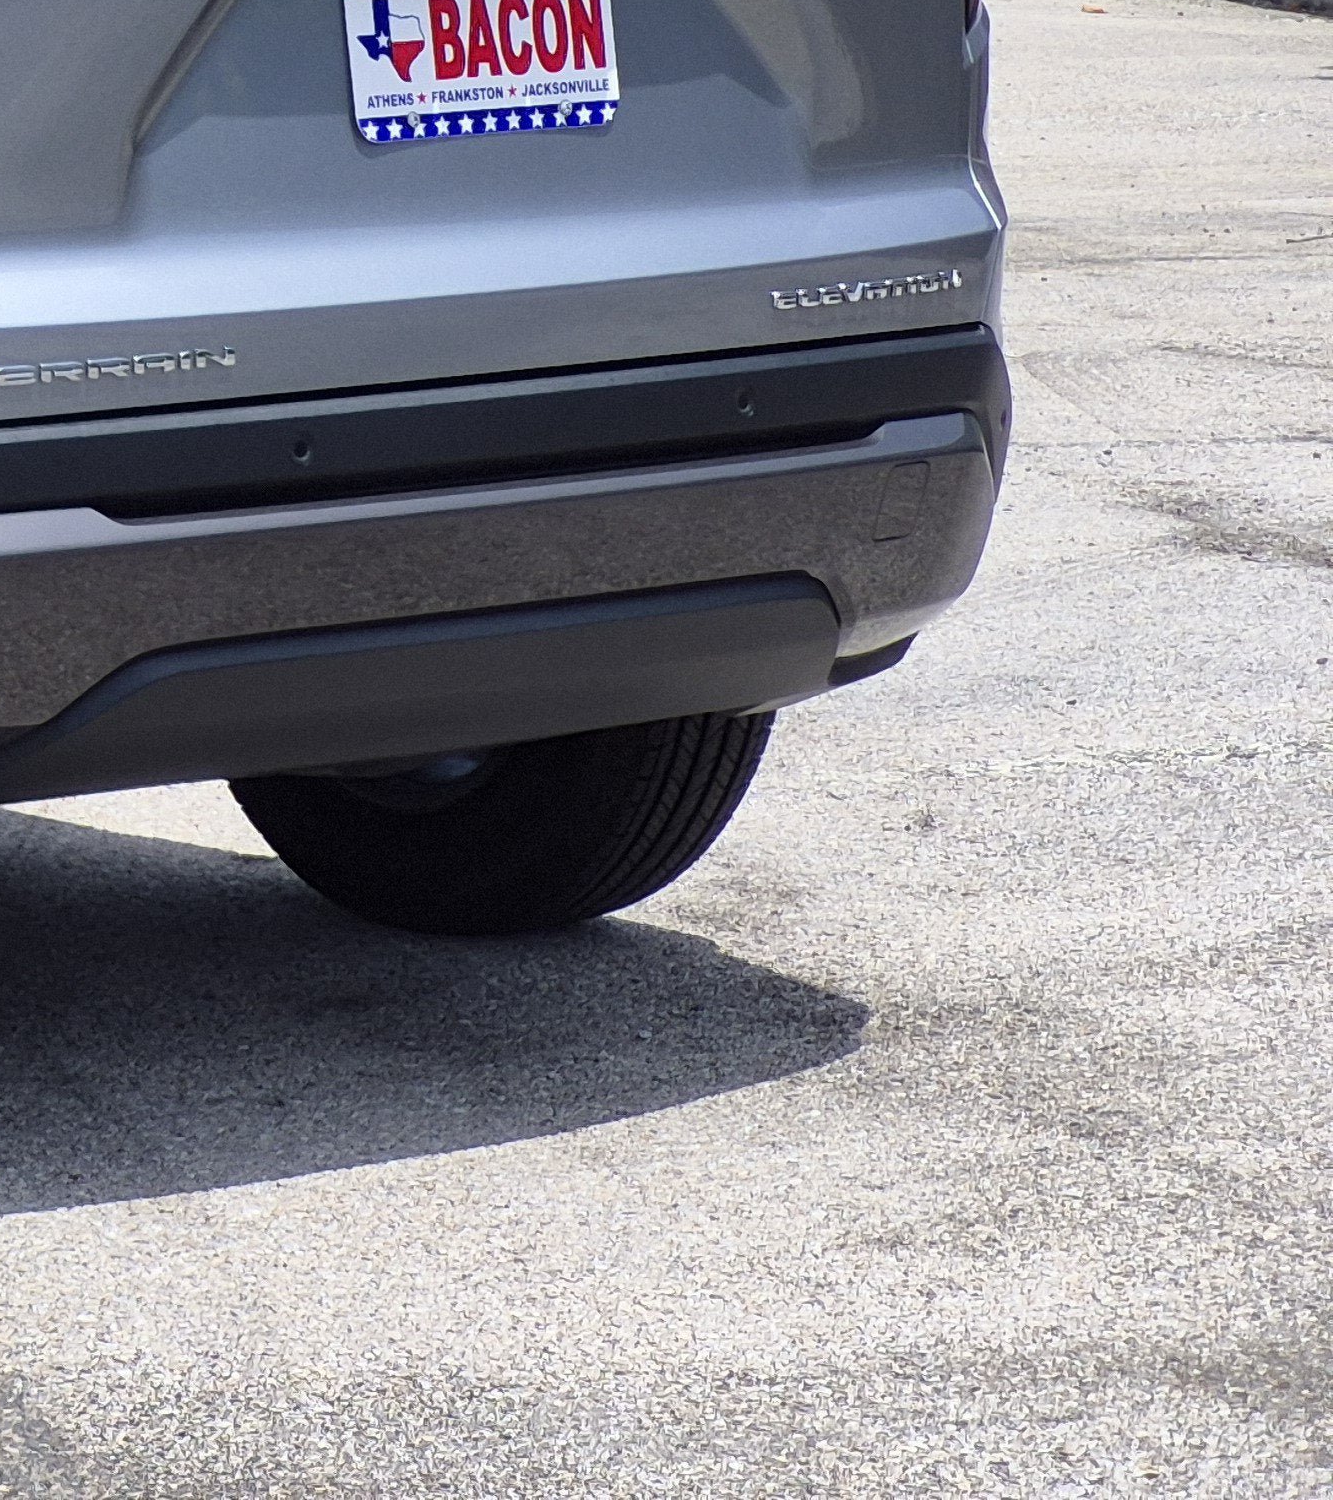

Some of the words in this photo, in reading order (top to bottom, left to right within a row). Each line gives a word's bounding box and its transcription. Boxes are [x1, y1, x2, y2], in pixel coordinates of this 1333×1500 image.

[367, 93, 415, 109] ATHENS
[431, 86, 504, 104] FRANKSTON
[521, 78, 610, 98] JACKSONVILLE
[771, 268, 963, 310] ELEVATION
